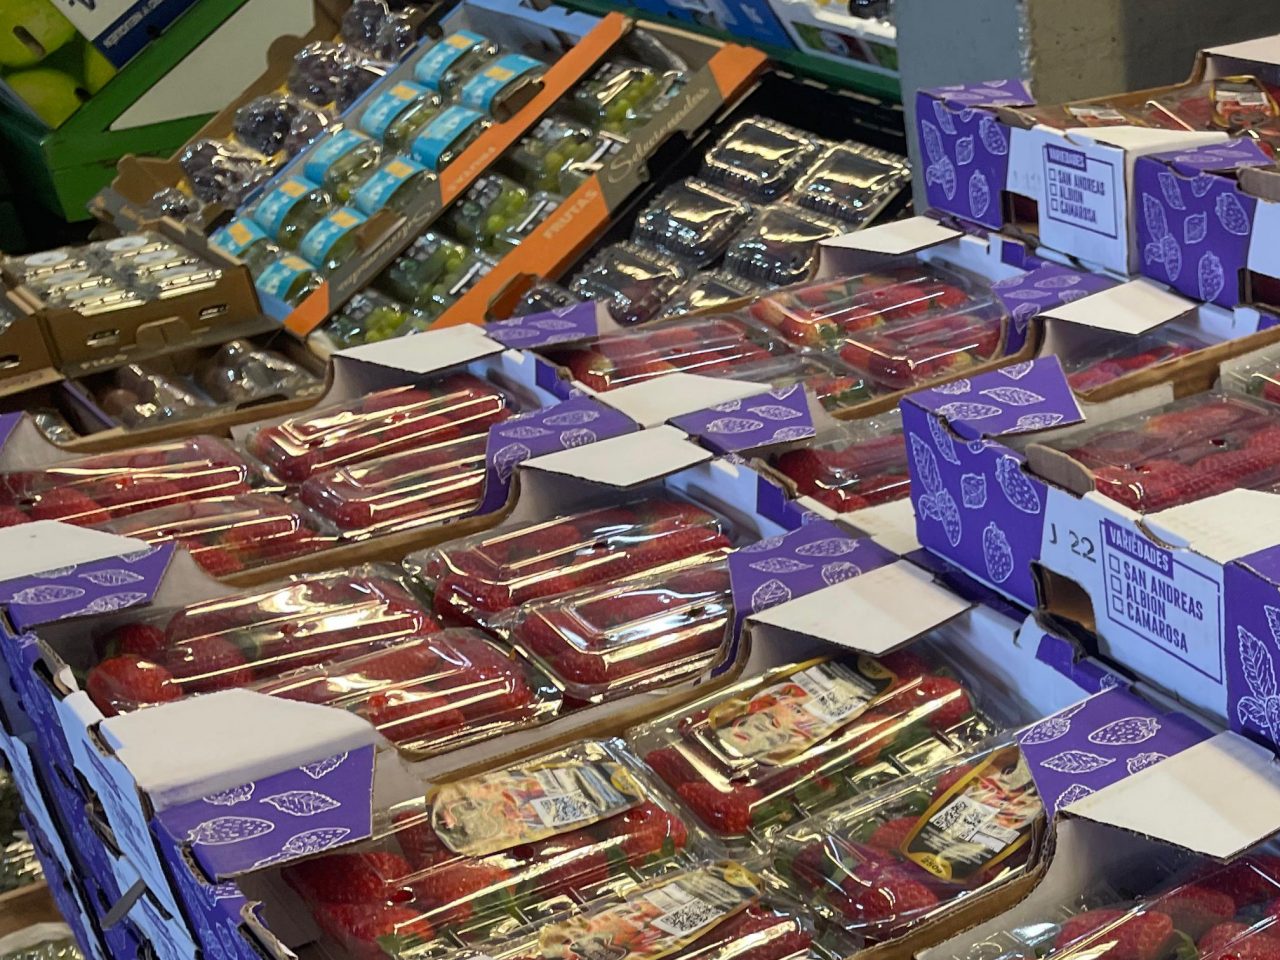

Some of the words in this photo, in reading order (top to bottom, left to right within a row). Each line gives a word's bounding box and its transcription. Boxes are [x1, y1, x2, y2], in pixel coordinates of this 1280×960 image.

[1058, 170, 1071, 185] SAN
[1074, 174, 1105, 196] ANDREAS
[543, 189, 598, 239] FRUTAS
[1060, 201, 1097, 224] CAMAROSA
[1069, 530, 1096, 563] 22
[1109, 526, 1169, 572] VARIEDADES
[1124, 561, 1147, 590] SAN
[1151, 577, 1203, 621] ANDREAS
[1126, 583, 1166, 621] ALBION
[1127, 602, 1188, 653] CAMAROSA
